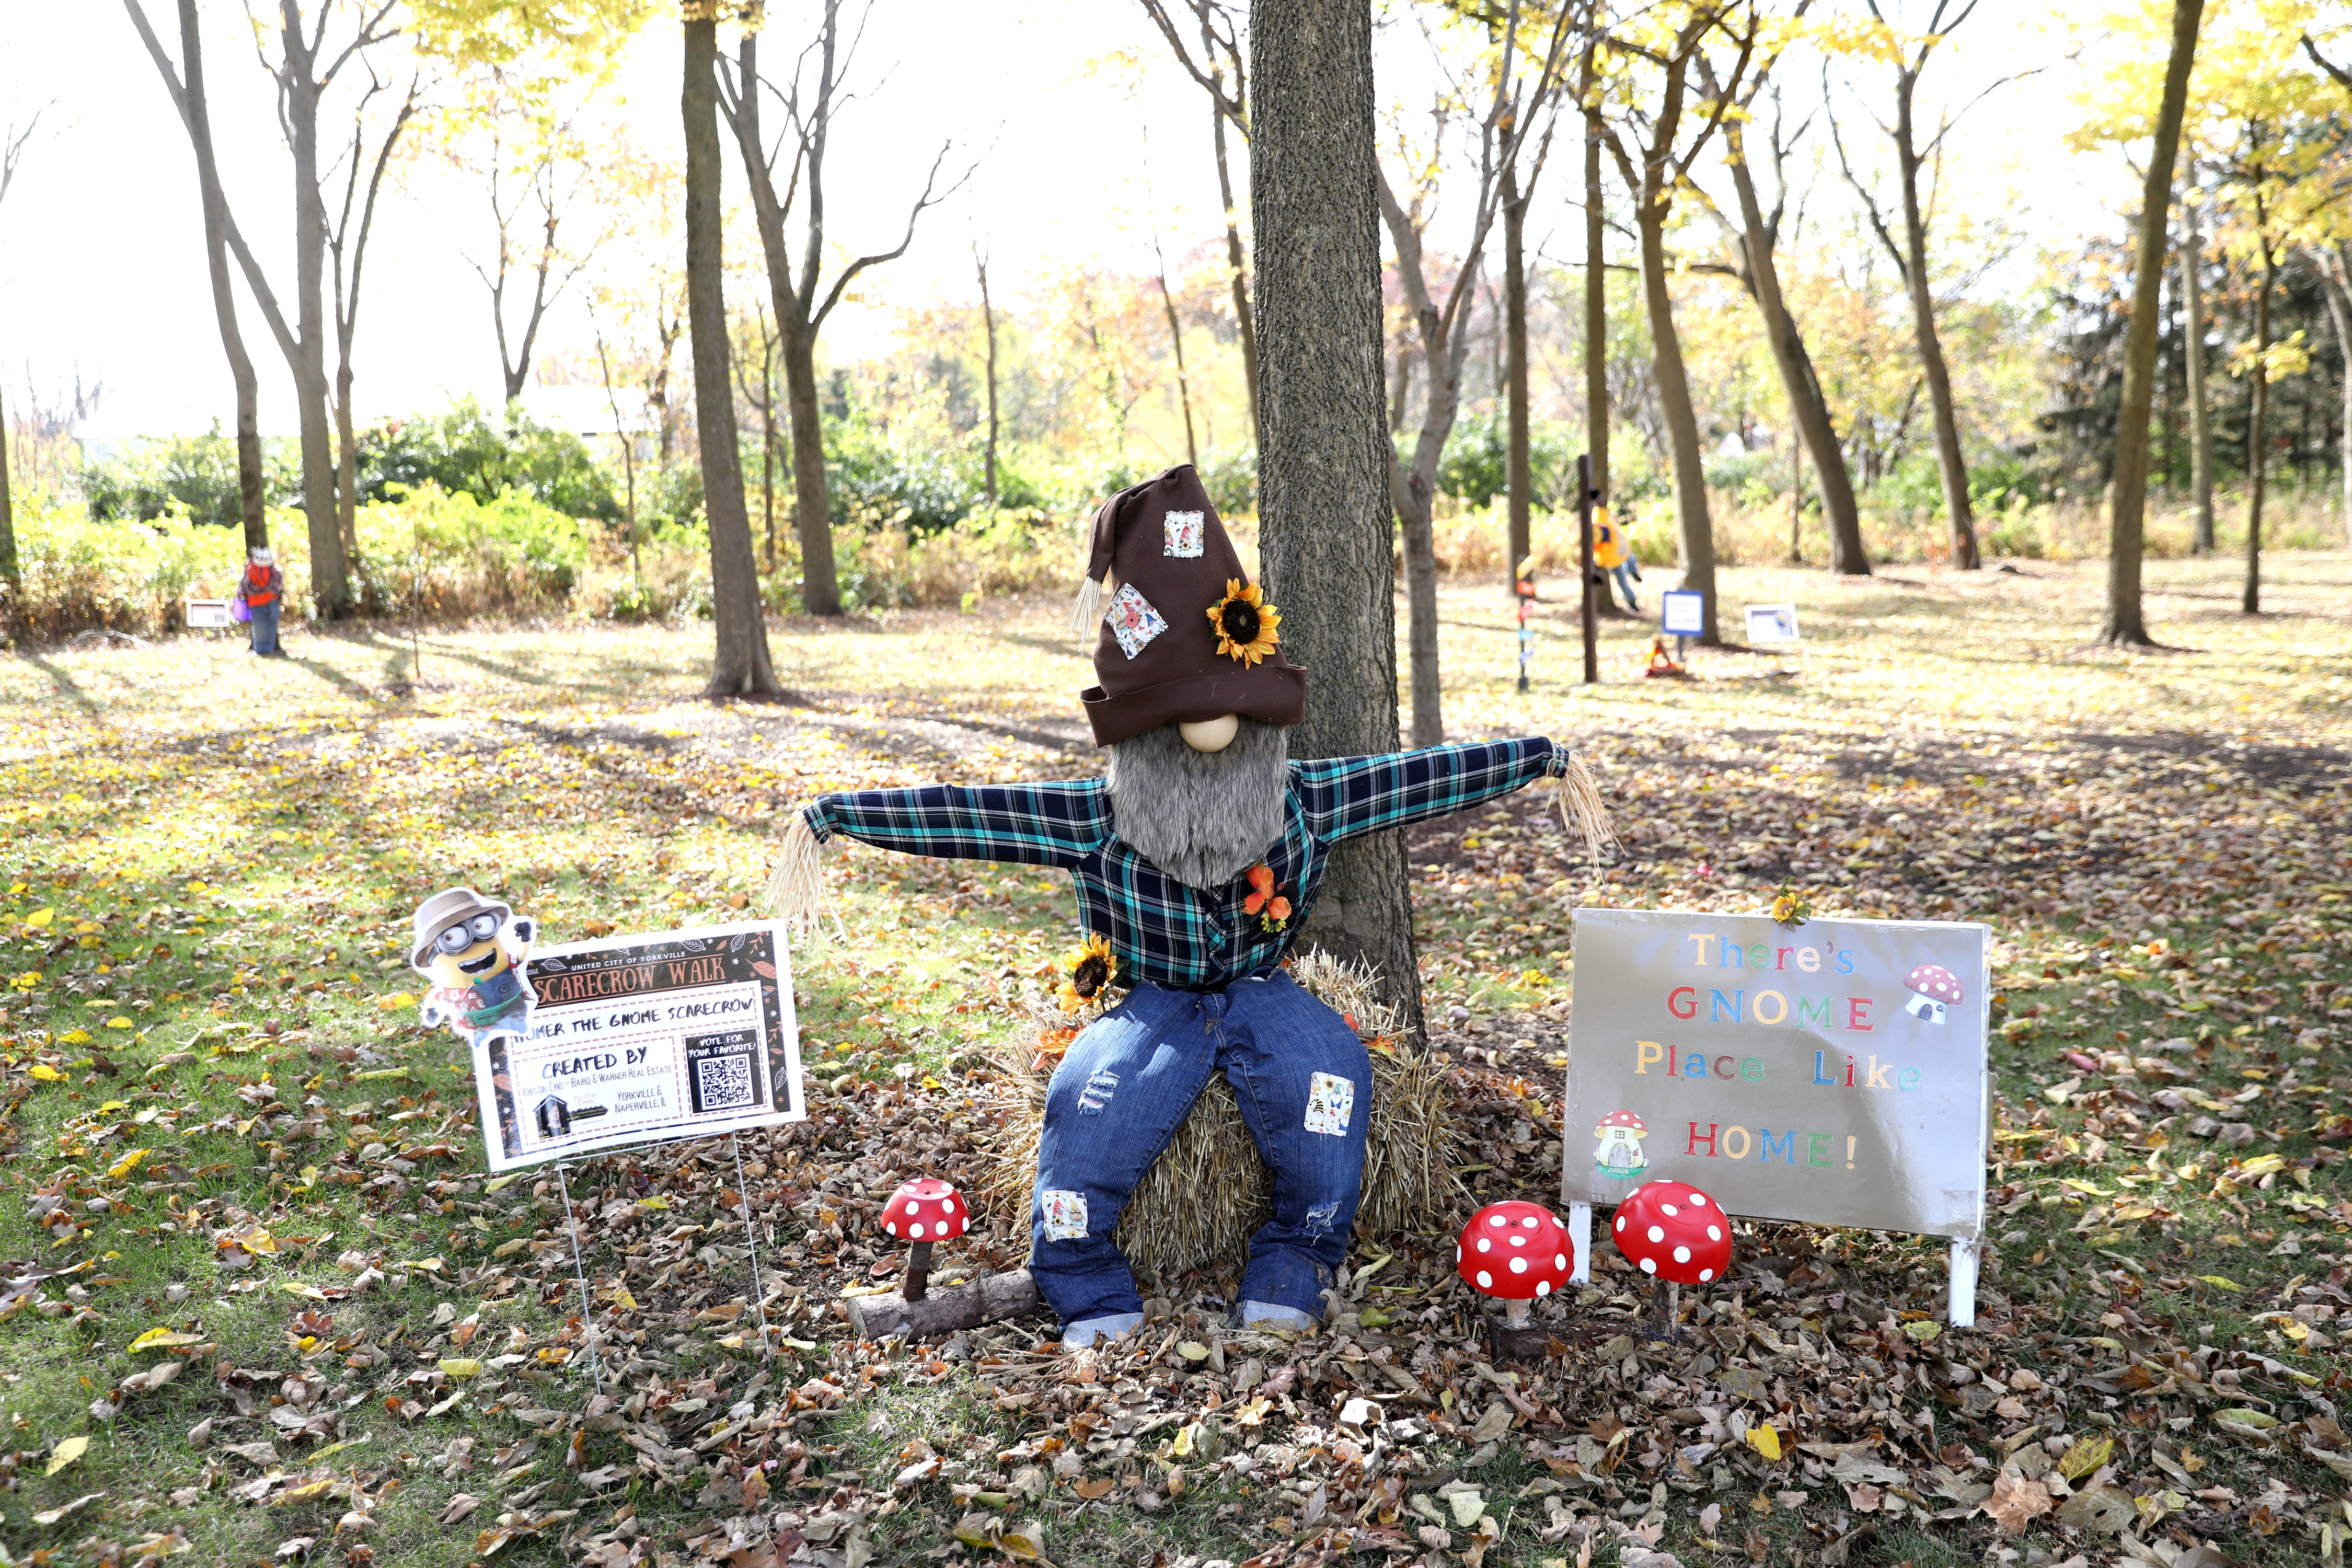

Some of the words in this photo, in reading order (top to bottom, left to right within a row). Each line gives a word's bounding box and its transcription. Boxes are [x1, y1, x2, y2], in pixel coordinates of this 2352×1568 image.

[572, 962, 601, 971] UNITED
[640, 951, 686, 962] YORKVILLE
[1687, 933, 1855, 975] There's
[534, 965, 656, 1004] SCARECROW
[668, 957, 726, 985] WALK
[571, 1017, 602, 1032] THE
[609, 1009, 661, 1027] GNOME
[667, 998, 753, 1020] SCARECROW
[1667, 986, 1874, 1032] GNOME
[688, 1048, 711, 1058] YOUR
[714, 1042, 756, 1055] FAVORITE!
[700, 1036, 723, 1046] VOTE
[726, 1034, 744, 1043] FOR
[542, 1054, 618, 1079] CREATED
[626, 1046, 648, 1065] BY
[1634, 1040, 1766, 1083] Place
[1812, 1050, 1923, 1091] Like
[523, 1085, 548, 1098] KRISTIN
[549, 1081, 565, 1093] CYKO
[571, 1077, 591, 1088] BAIRD
[593, 1074, 597, 1084] &
[598, 1071, 627, 1083] WARNER
[628, 1068, 645, 1078] REAL
[647, 1065, 673, 1076] ESTATE
[617, 1088, 654, 1101] YORKVILLE
[656, 1086, 662, 1096] &
[661, 1097, 667, 1107] IL
[1684, 1121, 1857, 1171] HOME!
